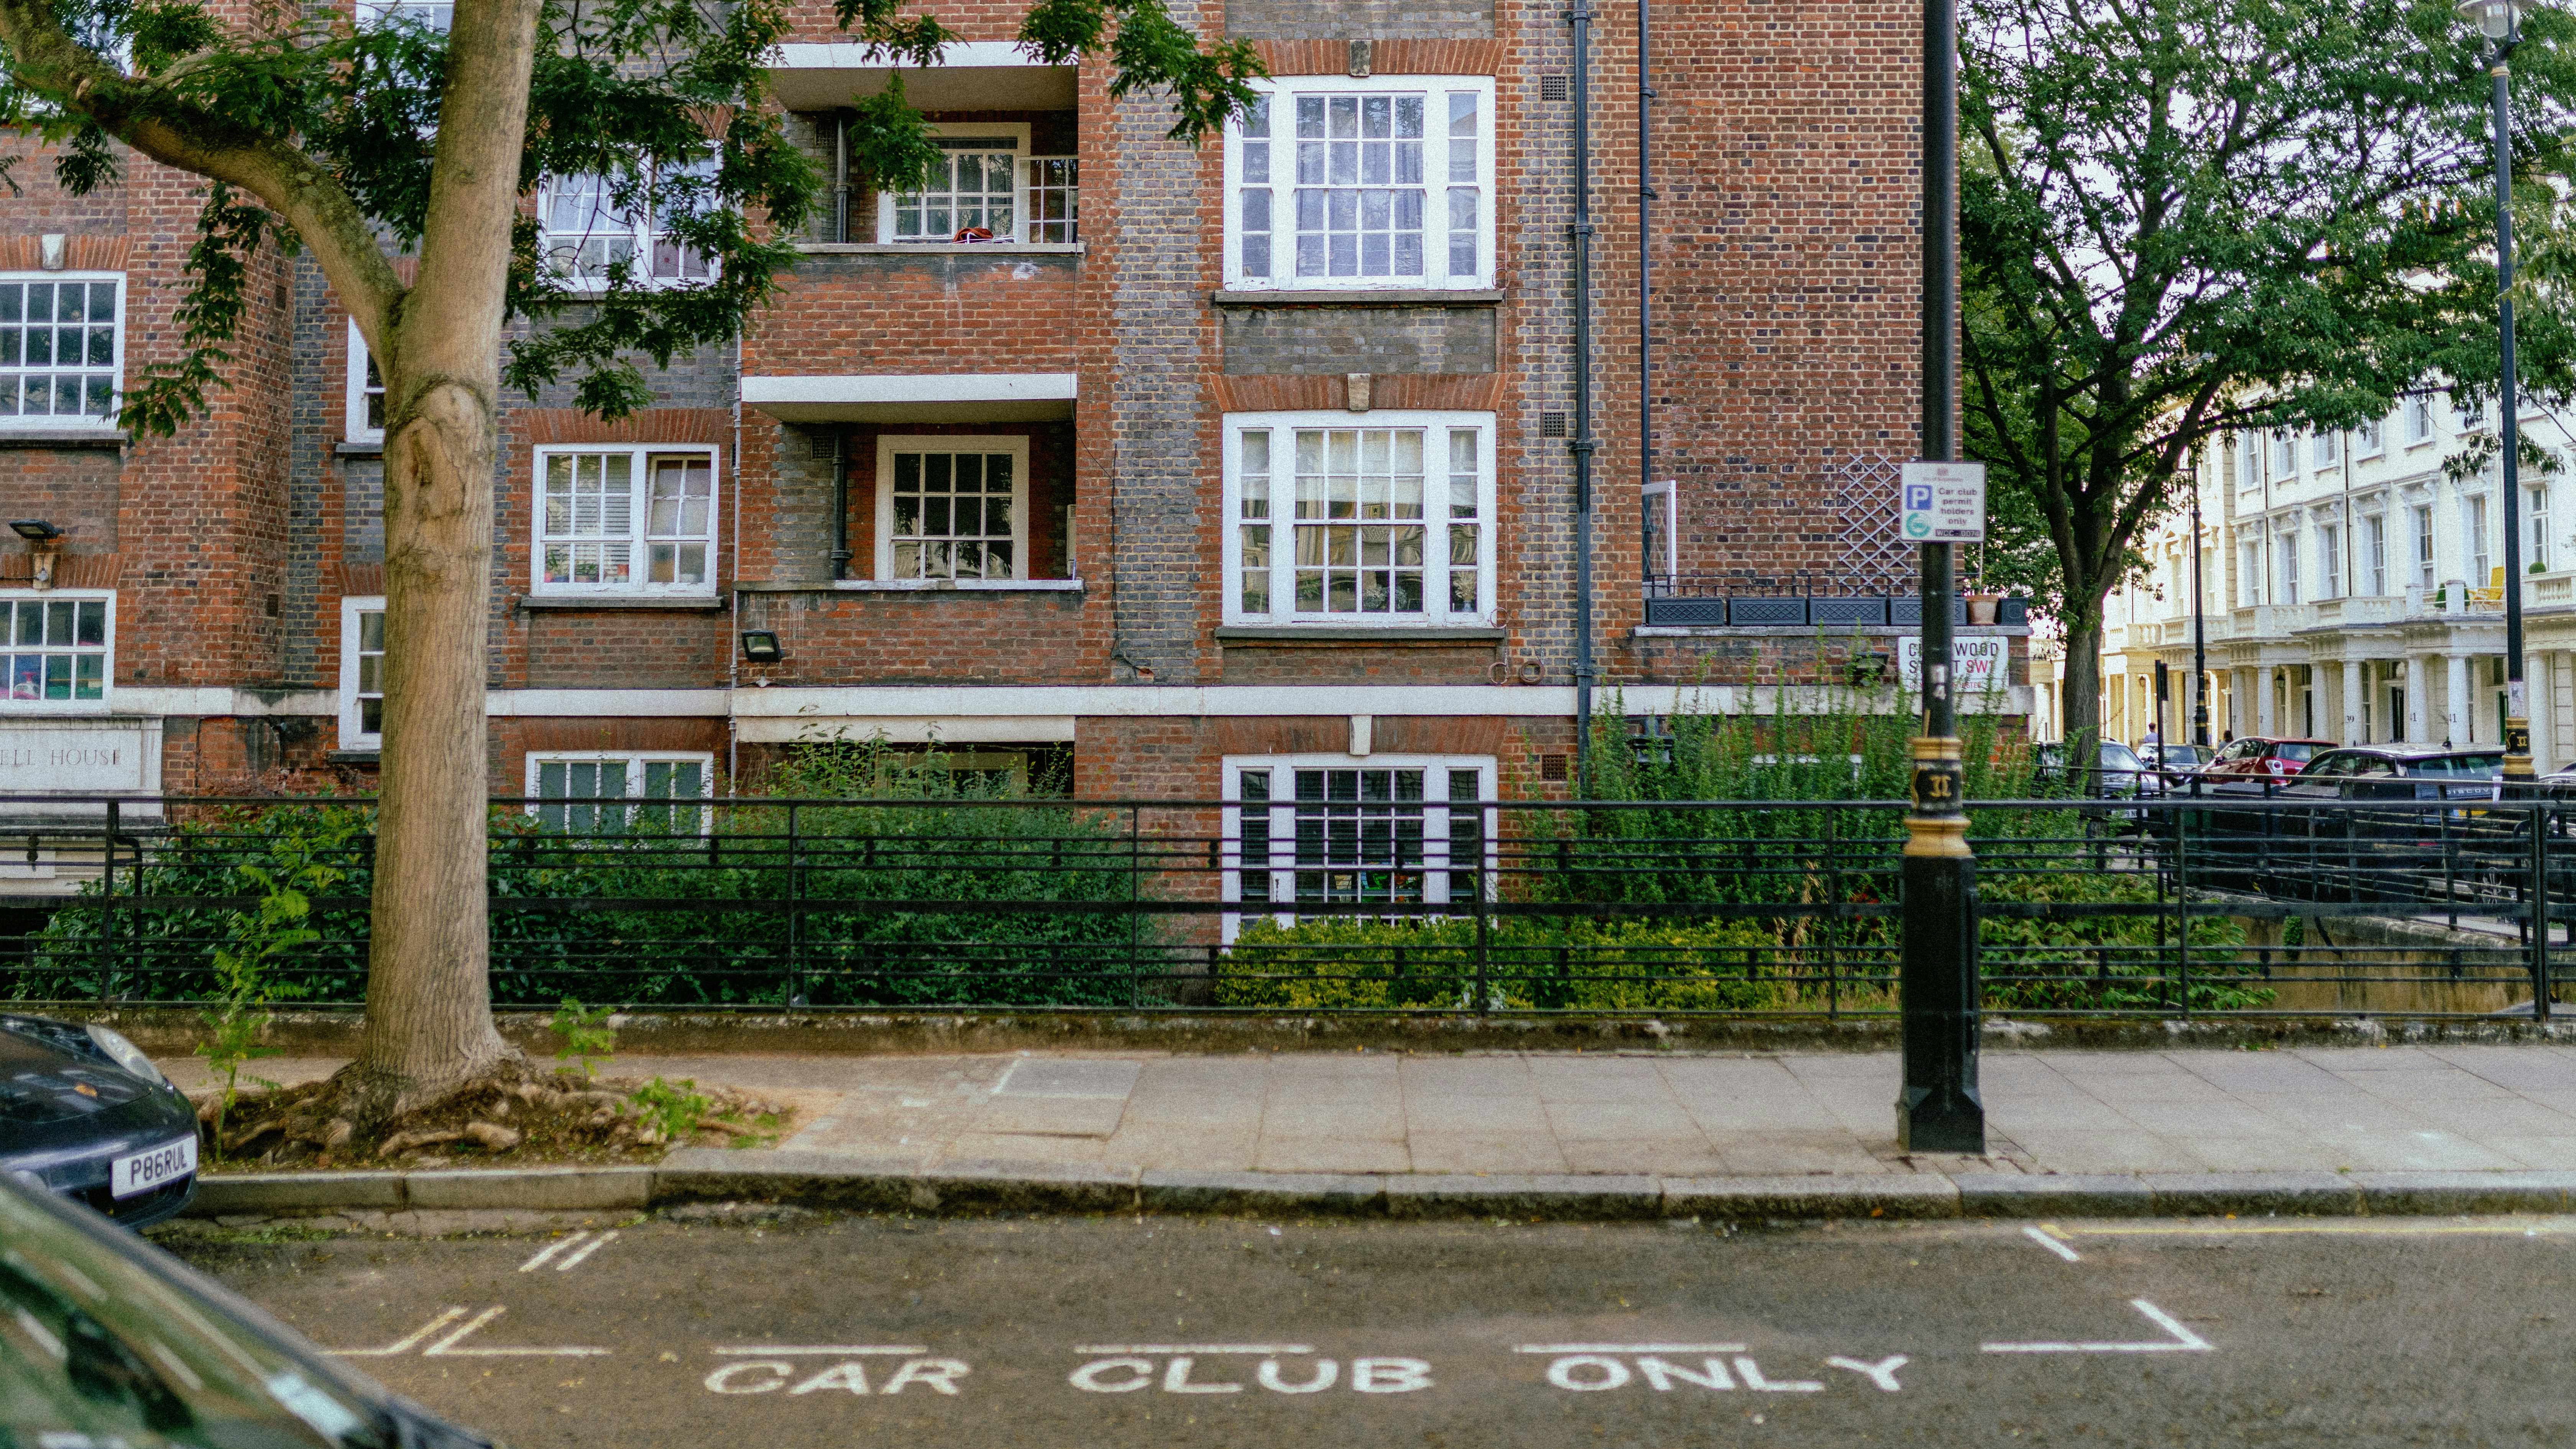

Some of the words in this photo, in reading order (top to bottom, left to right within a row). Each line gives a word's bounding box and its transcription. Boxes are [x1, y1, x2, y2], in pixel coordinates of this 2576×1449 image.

[1913, 487, 1929, 508] P
[1948, 517, 1967, 525] only
[1909, 643, 1998, 656] CWOOD
[2345, 715, 2354, 723] 39
[51, 749, 121, 766] HOUSE
[704, 1359, 971, 1395] CAR
[1069, 1356, 1435, 1393] CLUB
[1546, 1354, 1910, 1392] ONLY
